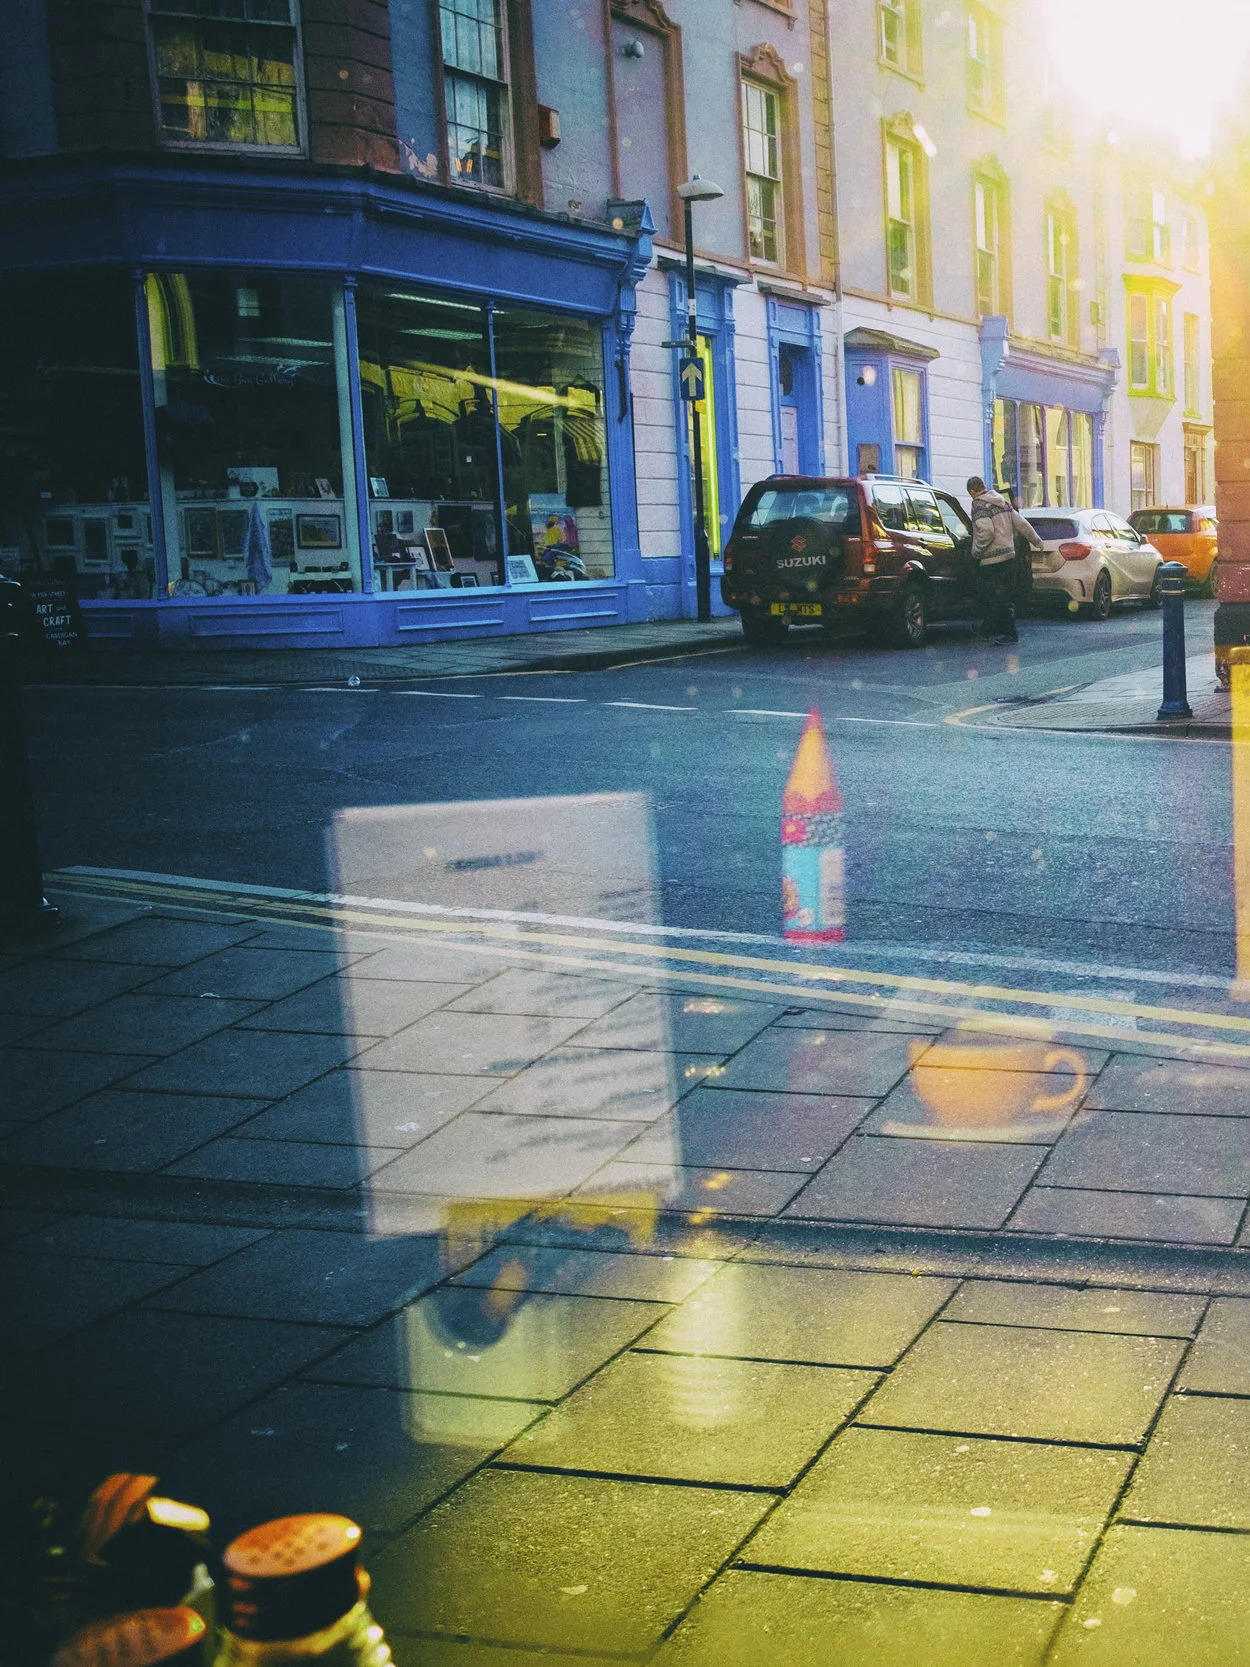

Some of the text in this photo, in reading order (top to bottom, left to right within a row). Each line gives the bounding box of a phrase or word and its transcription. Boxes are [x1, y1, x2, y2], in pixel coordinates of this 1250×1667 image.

[776, 555, 826, 569] SUZUKI
[36, 603, 53, 615] ART
[43, 615, 72, 627] CRAFT
